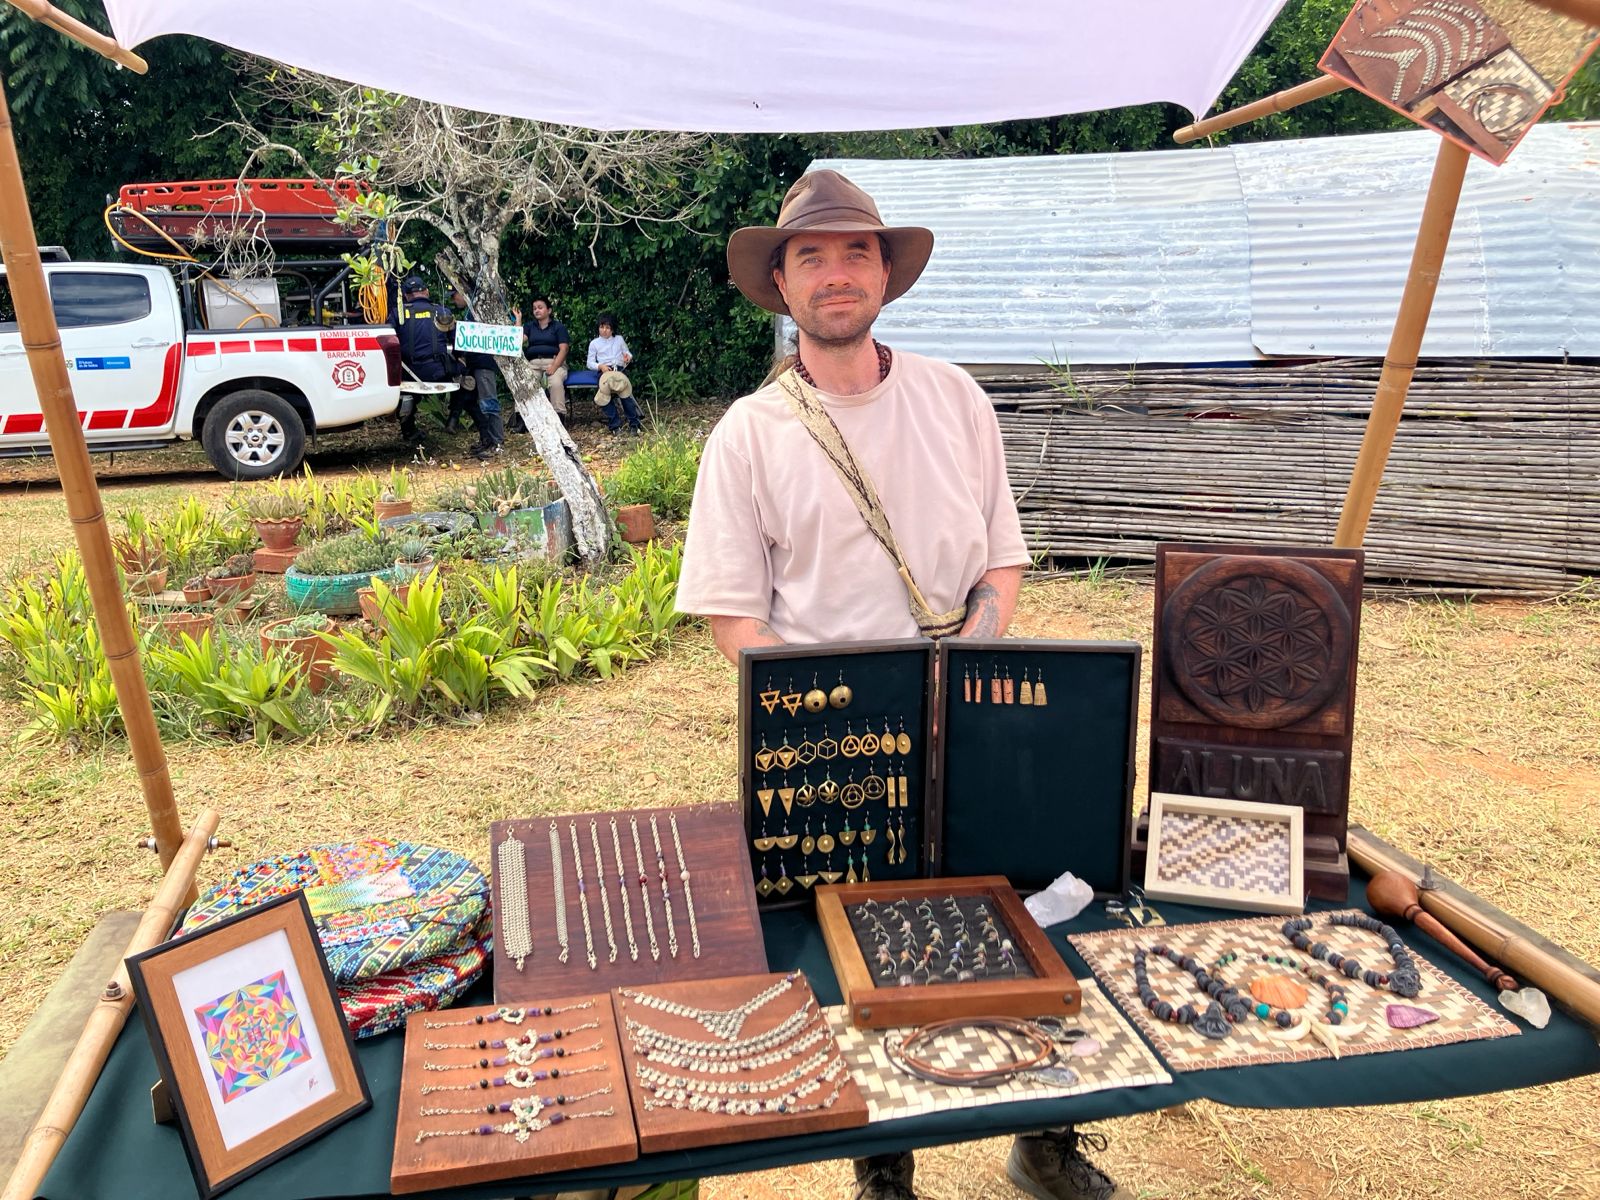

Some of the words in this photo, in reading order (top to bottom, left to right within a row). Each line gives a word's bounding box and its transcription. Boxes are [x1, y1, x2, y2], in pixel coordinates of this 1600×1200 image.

[319, 330, 370, 338] BOMBEROS
[327, 351, 366, 359] BARICHARA
[1171, 750, 1328, 807] ALUNA
